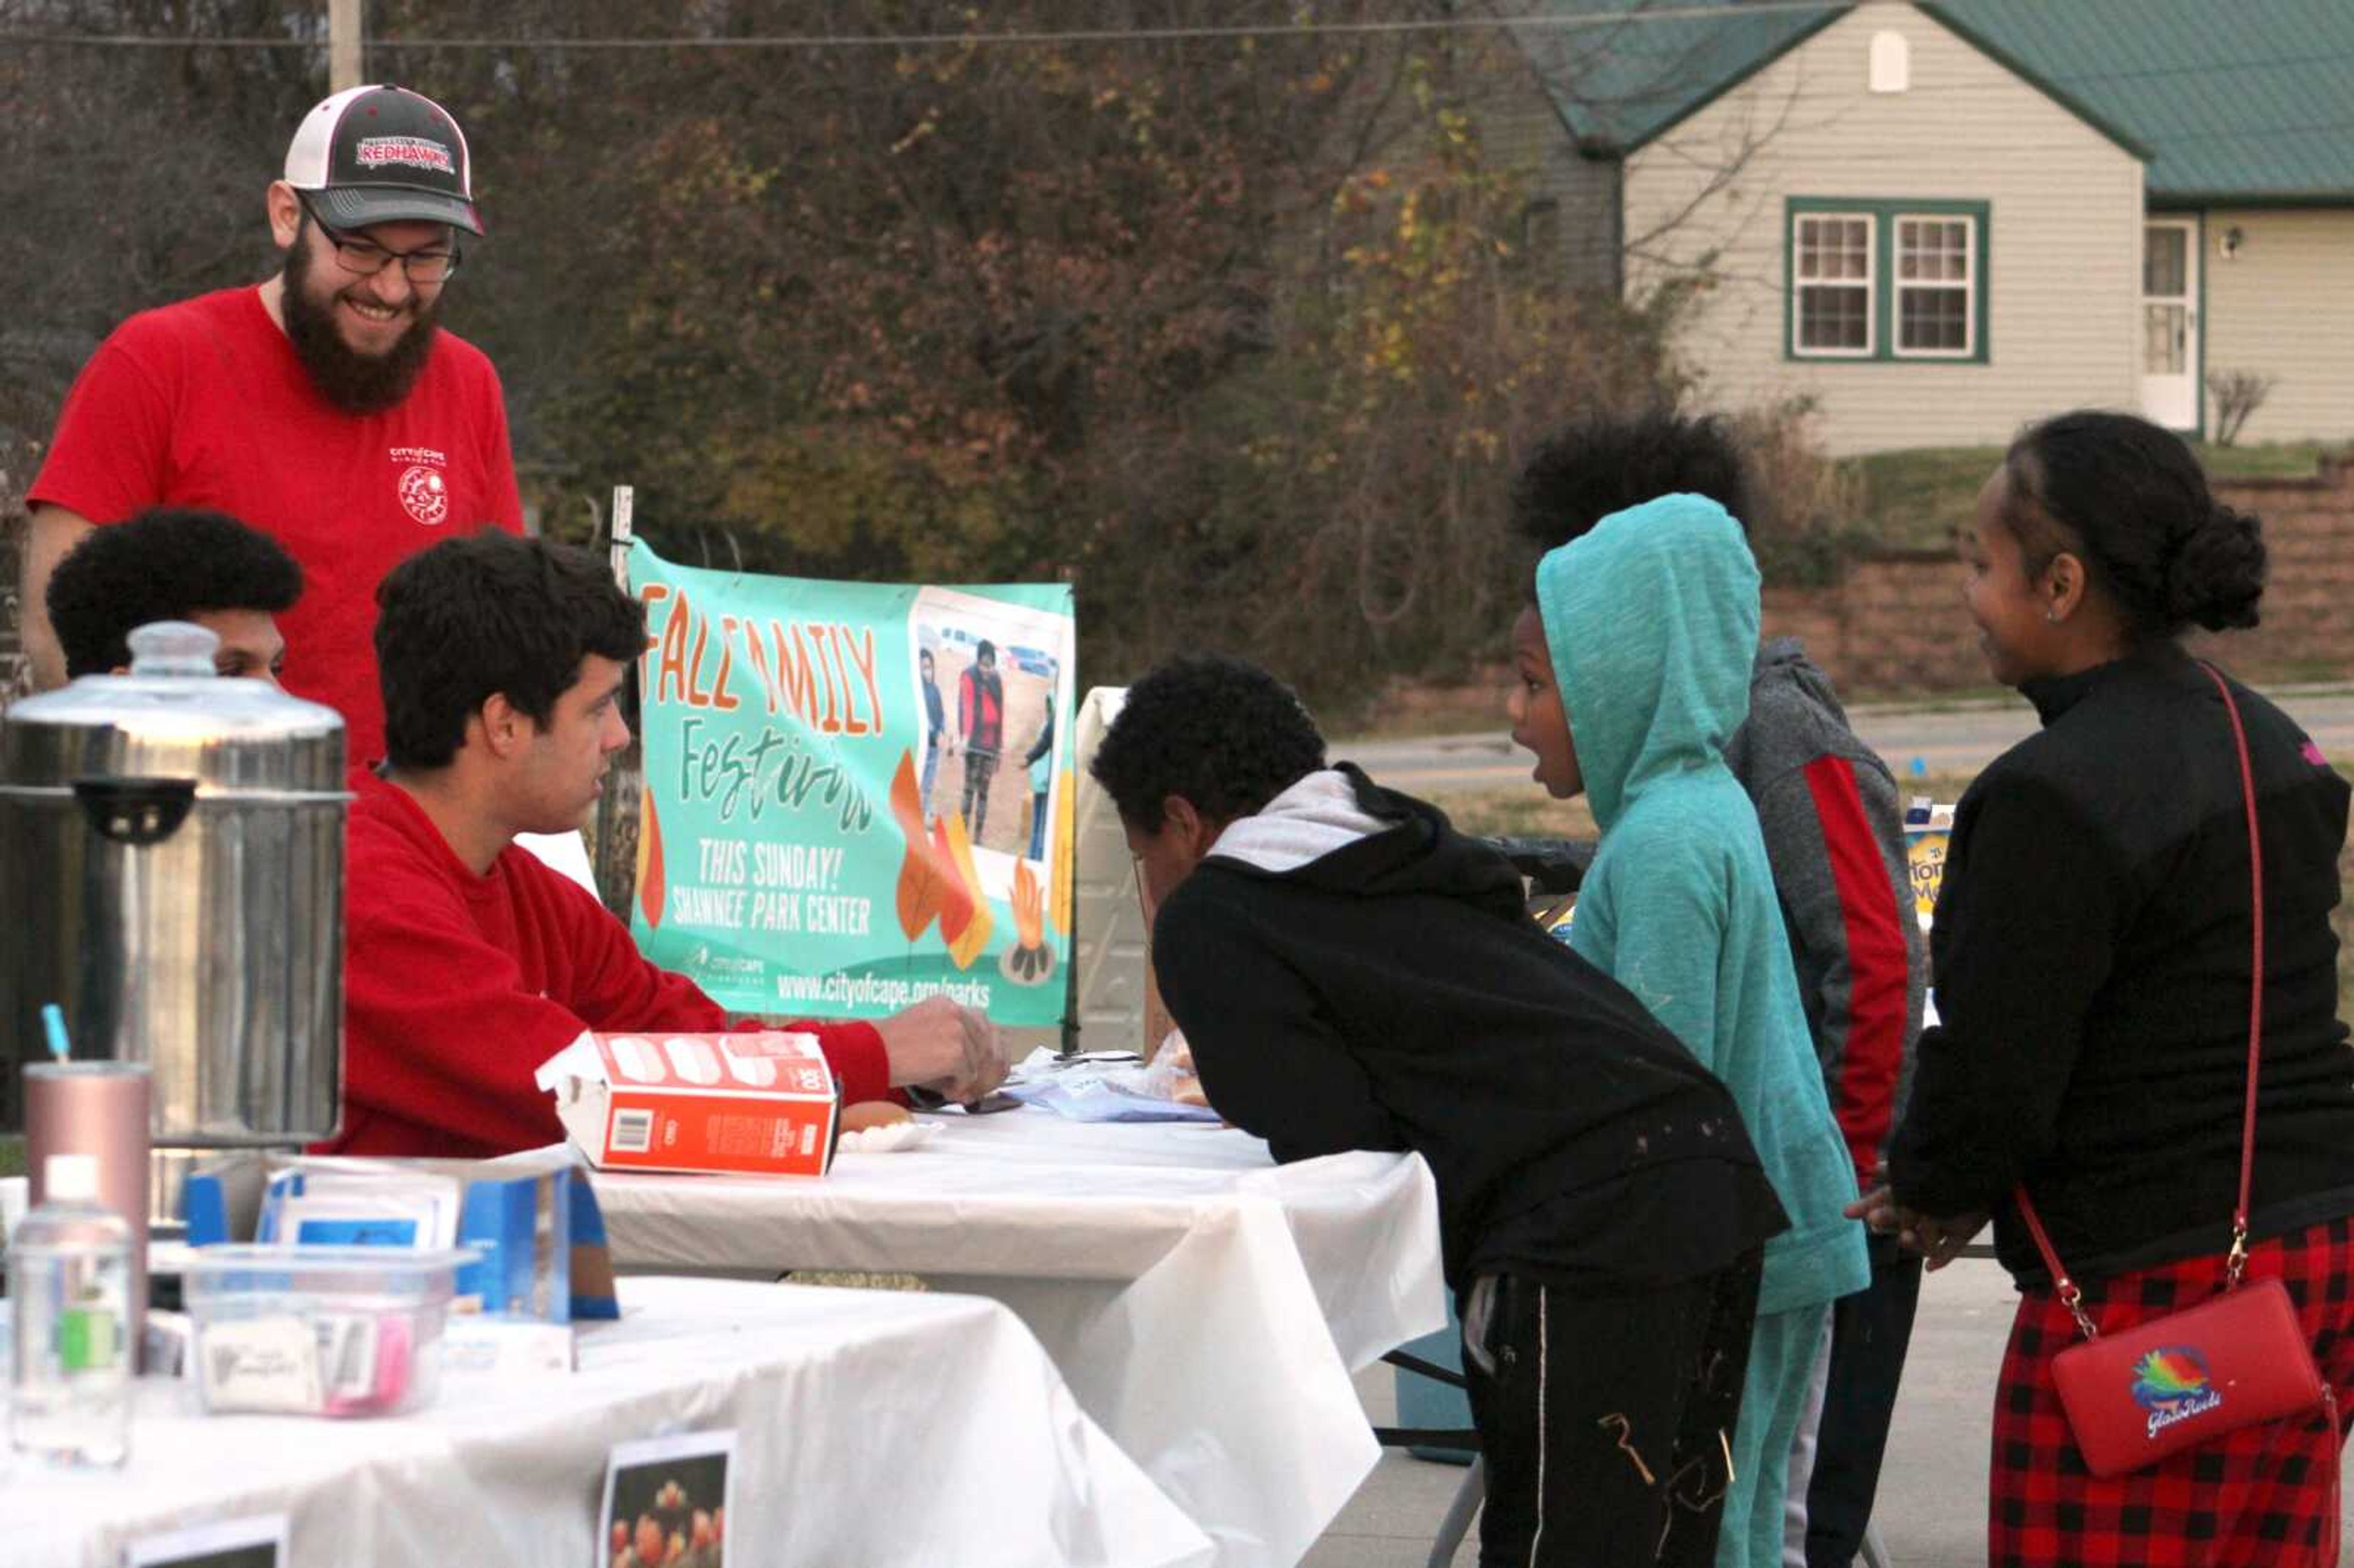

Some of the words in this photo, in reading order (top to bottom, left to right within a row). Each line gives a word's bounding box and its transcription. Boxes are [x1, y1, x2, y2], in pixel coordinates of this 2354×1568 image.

[699, 838, 747, 884] THIS
[753, 841, 844, 891] SUNDAY!
[672, 885, 747, 928] SHAWNEE
[750, 891, 802, 931] PARK
[806, 893, 870, 936] CENTER
